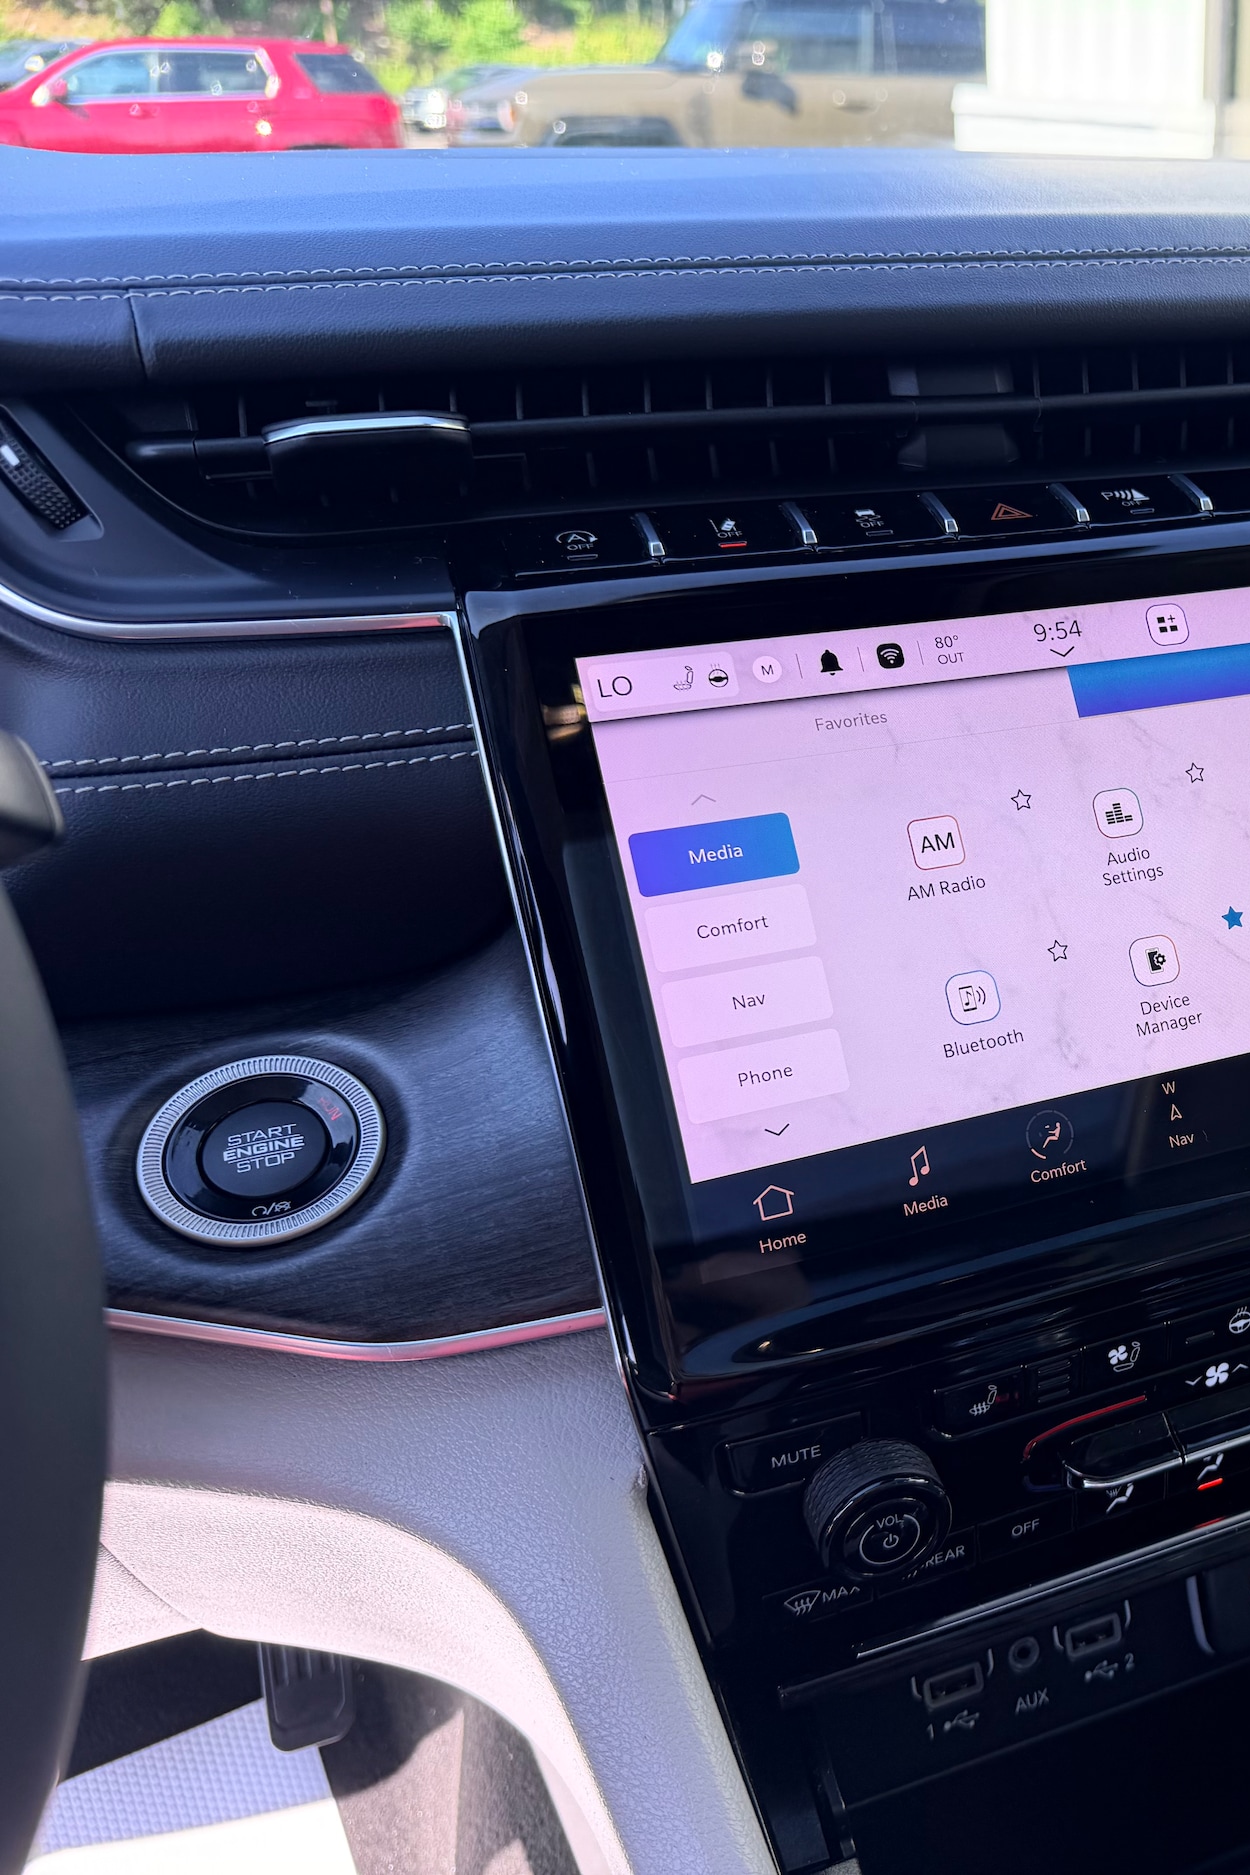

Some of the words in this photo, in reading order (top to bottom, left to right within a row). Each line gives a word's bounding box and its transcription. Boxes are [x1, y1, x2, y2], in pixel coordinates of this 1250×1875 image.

[717, 530, 743, 539] OFF
[860, 520, 884, 528] OFF
[567, 543, 594, 551] OFF
[934, 634, 959, 649] 80°
[1033, 619, 1083, 643] 9:54
[937, 651, 964, 665] OUT
[761, 665, 774, 676] M
[597, 675, 633, 698] LO
[814, 711, 888, 731] Favorites
[920, 832, 956, 853] AM
[689, 844, 744, 865] Media
[1107, 847, 1150, 865] Audio
[1102, 864, 1164, 887] Settings
[907, 884, 935, 901] AM
[940, 874, 986, 896] Radio
[696, 915, 769, 940] Comfort
[732, 993, 766, 1010] Nav
[1140, 993, 1191, 1015] Device
[1136, 1011, 1202, 1038] Manager
[942, 1029, 1025, 1059] Bluetooth
[737, 1063, 793, 1087] Phone
[1162, 1082, 1175, 1094] W
[227, 1123, 297, 1147] START
[1169, 1133, 1194, 1148] Nav
[223, 1135, 305, 1162] ENGINE
[236, 1151, 295, 1173] STOP
[1030, 1159, 1087, 1183] Comfort
[904, 1194, 948, 1216] Media
[759, 1231, 806, 1254] Home
[771, 1445, 821, 1468] MUTE
[876, 1514, 904, 1529] VOL
[1011, 1519, 1039, 1537] OFF
[1124, 1653, 1135, 1671] 2
[1015, 1688, 1049, 1714] AUX
[926, 1724, 935, 1740] 1
